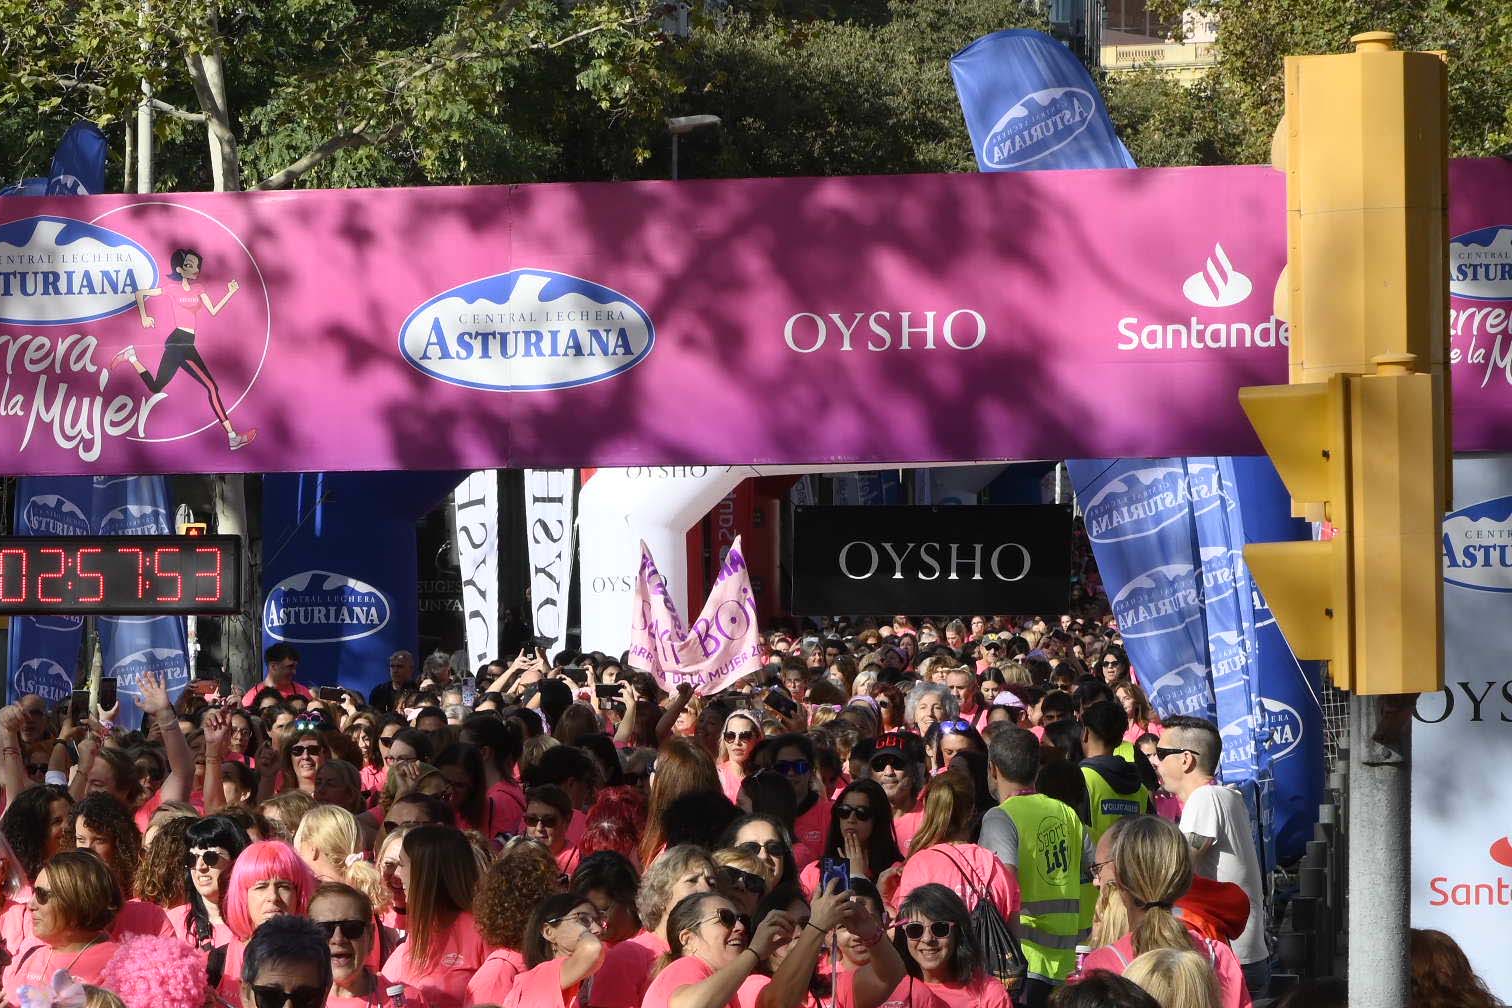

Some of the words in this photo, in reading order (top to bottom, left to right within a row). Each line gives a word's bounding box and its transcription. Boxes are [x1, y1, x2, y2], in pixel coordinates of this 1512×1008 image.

[62, 253, 133, 265] LECHERA
[459, 310, 537, 324] CENTRAL
[545, 309, 626, 322] LECHERA
[783, 308, 988, 353] OYSHO
[1118, 313, 1289, 351] Santande
[419, 317, 634, 360] ASTURIANA
[1467, 335, 1486, 364] la
[0, 377, 26, 417] la
[19, 368, 169, 462] Mujer
[0, 548, 221, 602] 02:57:53
[838, 540, 1032, 581] OYSHO
[593, 575, 668, 594] OYS
[268, 599, 380, 627] ASTURIANA
[709, 651, 749, 682] MUJER
[1044, 840, 1068, 874] Lif
[1430, 876, 1512, 907] Sant
